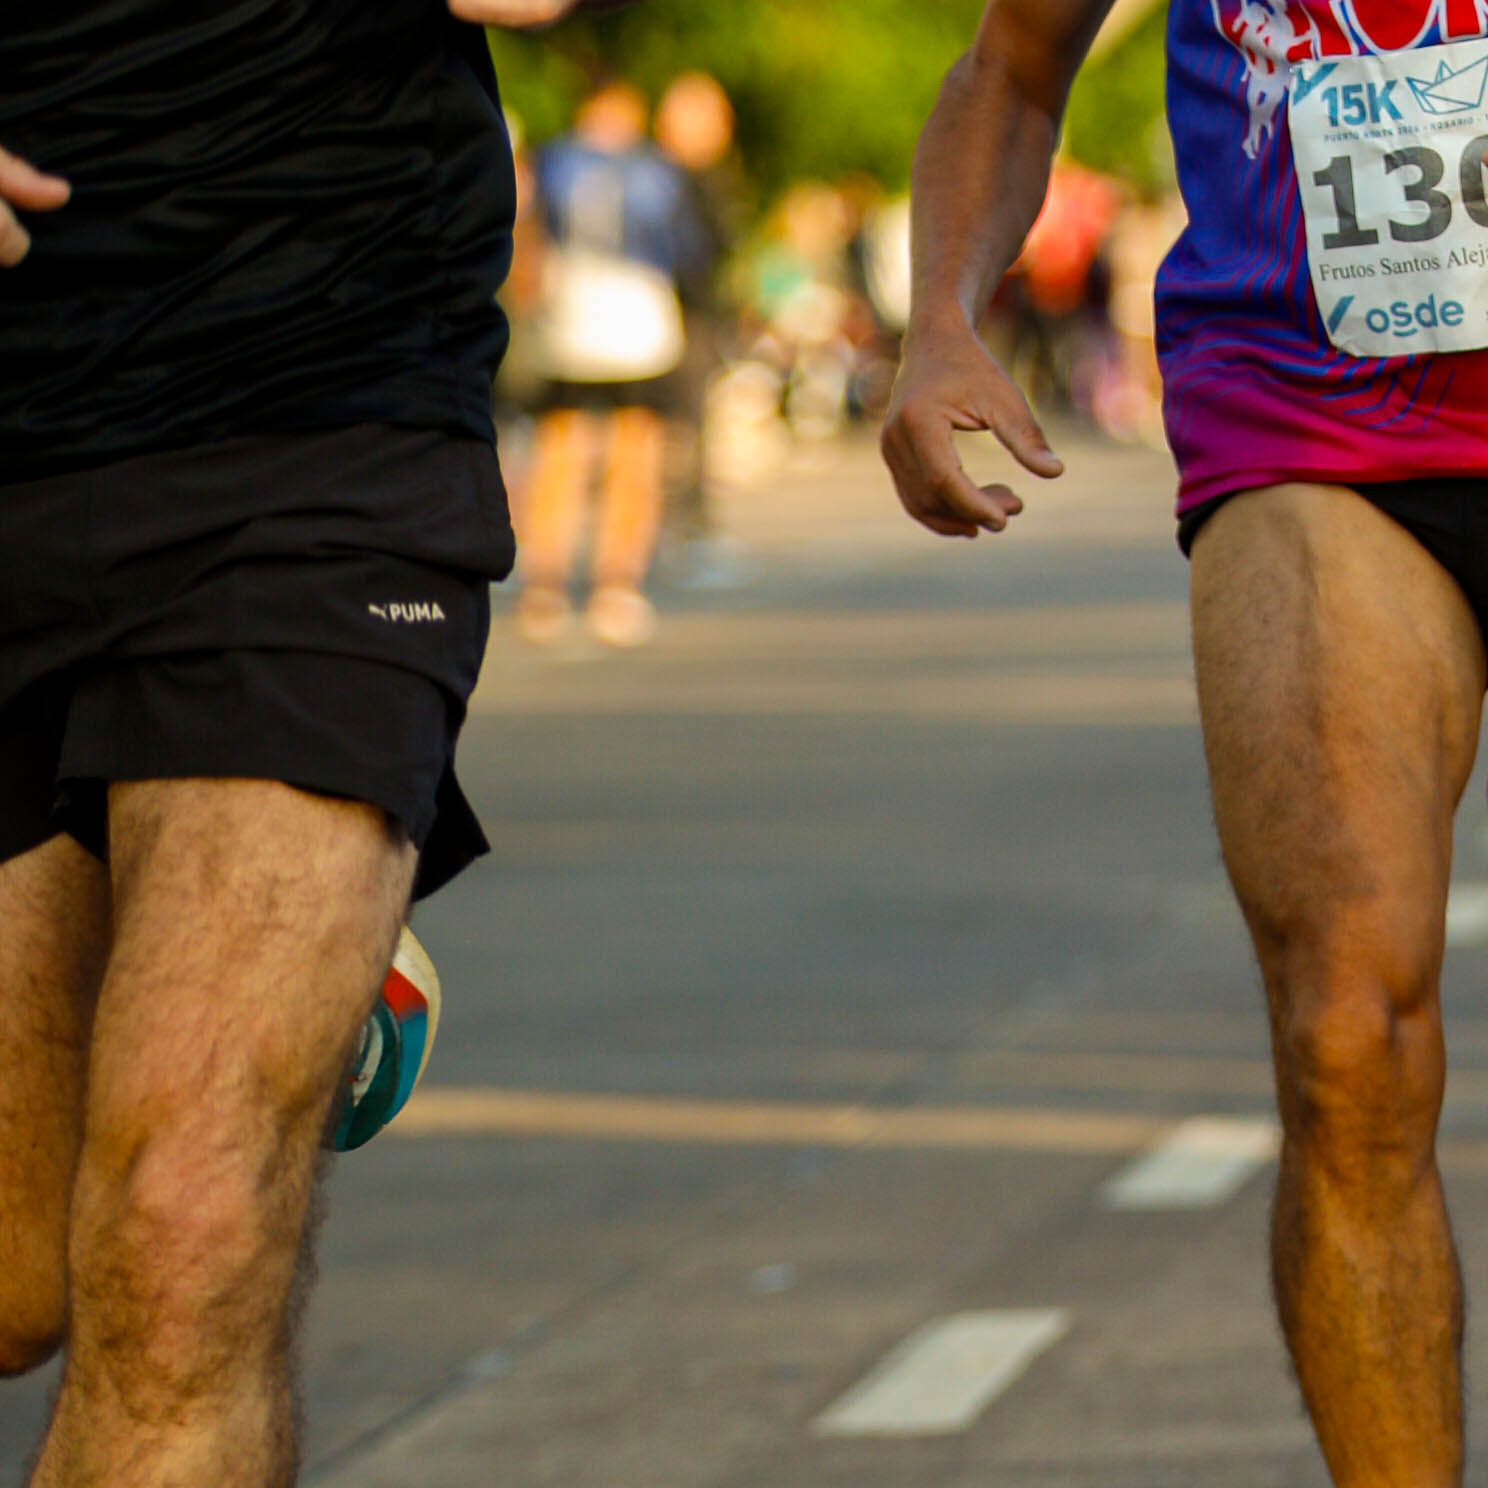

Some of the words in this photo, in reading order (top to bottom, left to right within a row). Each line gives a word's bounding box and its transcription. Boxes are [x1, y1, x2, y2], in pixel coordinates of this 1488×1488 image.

[1320, 78, 1404, 127] 15K
[1319, 261, 1376, 282] Frutos
[1380, 255, 1441, 277] Santos
[1365, 292, 1465, 334] osde
[389, 601, 446, 623] PUMA
